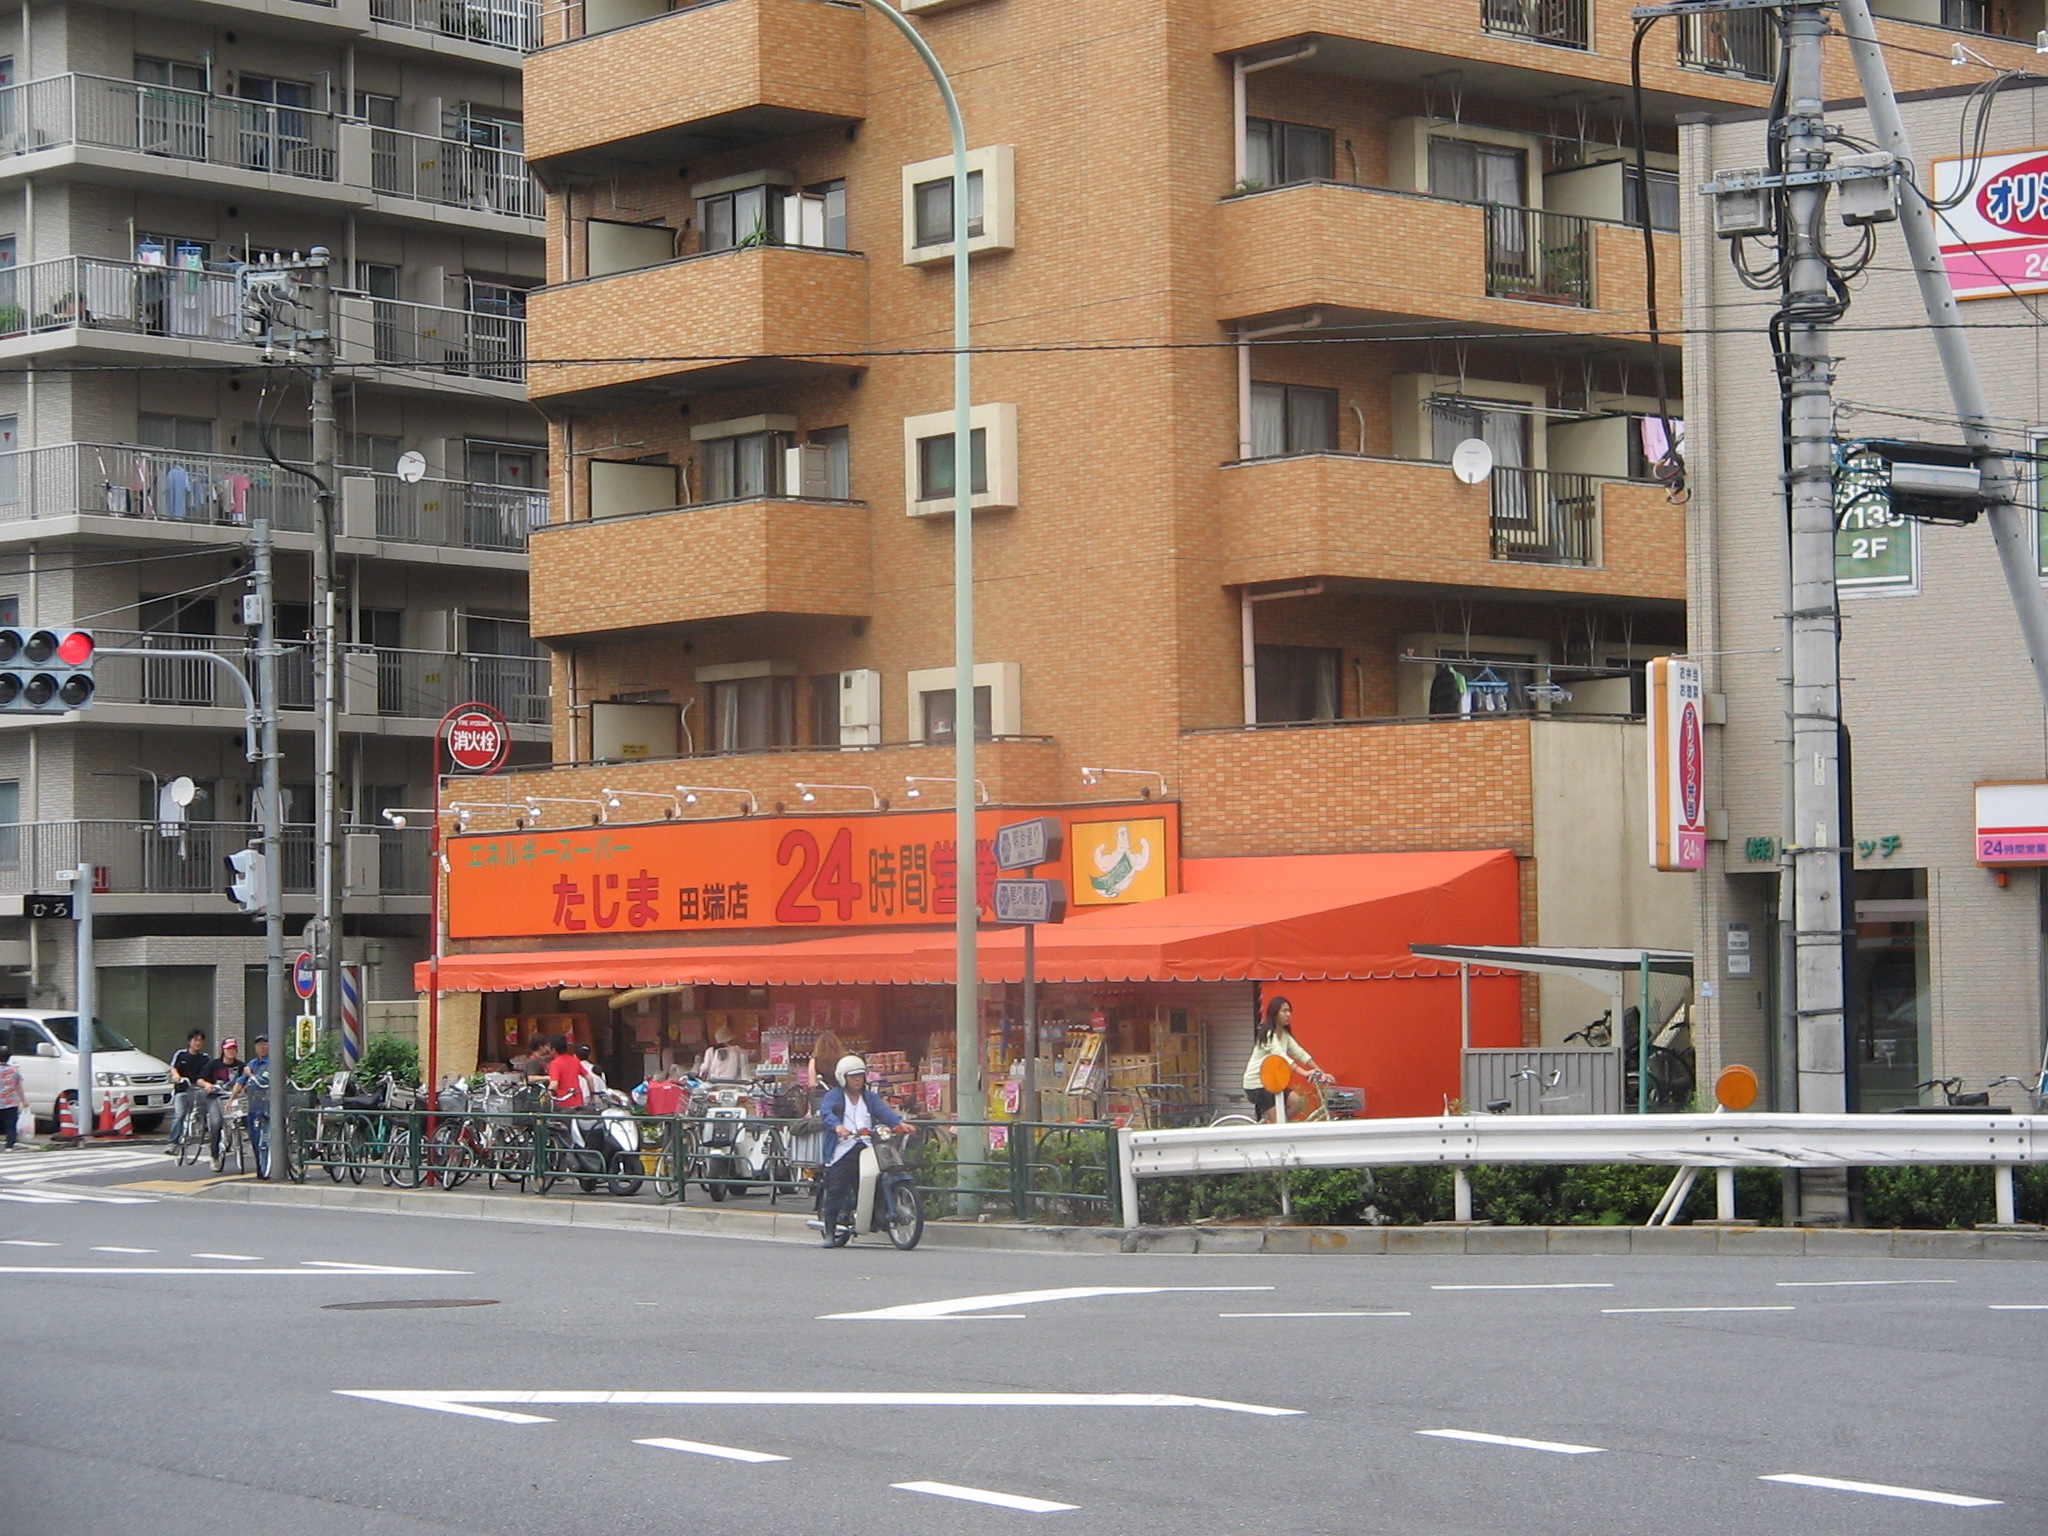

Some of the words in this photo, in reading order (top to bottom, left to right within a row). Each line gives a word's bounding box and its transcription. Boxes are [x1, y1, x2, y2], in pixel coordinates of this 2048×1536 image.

[1852, 537, 1888, 558] 2F
[453, 730, 496, 752] 消火栓
[32, 902, 68, 917] ひろ
[553, 869, 660, 931] たじま
[679, 881, 748, 922] 田端店
